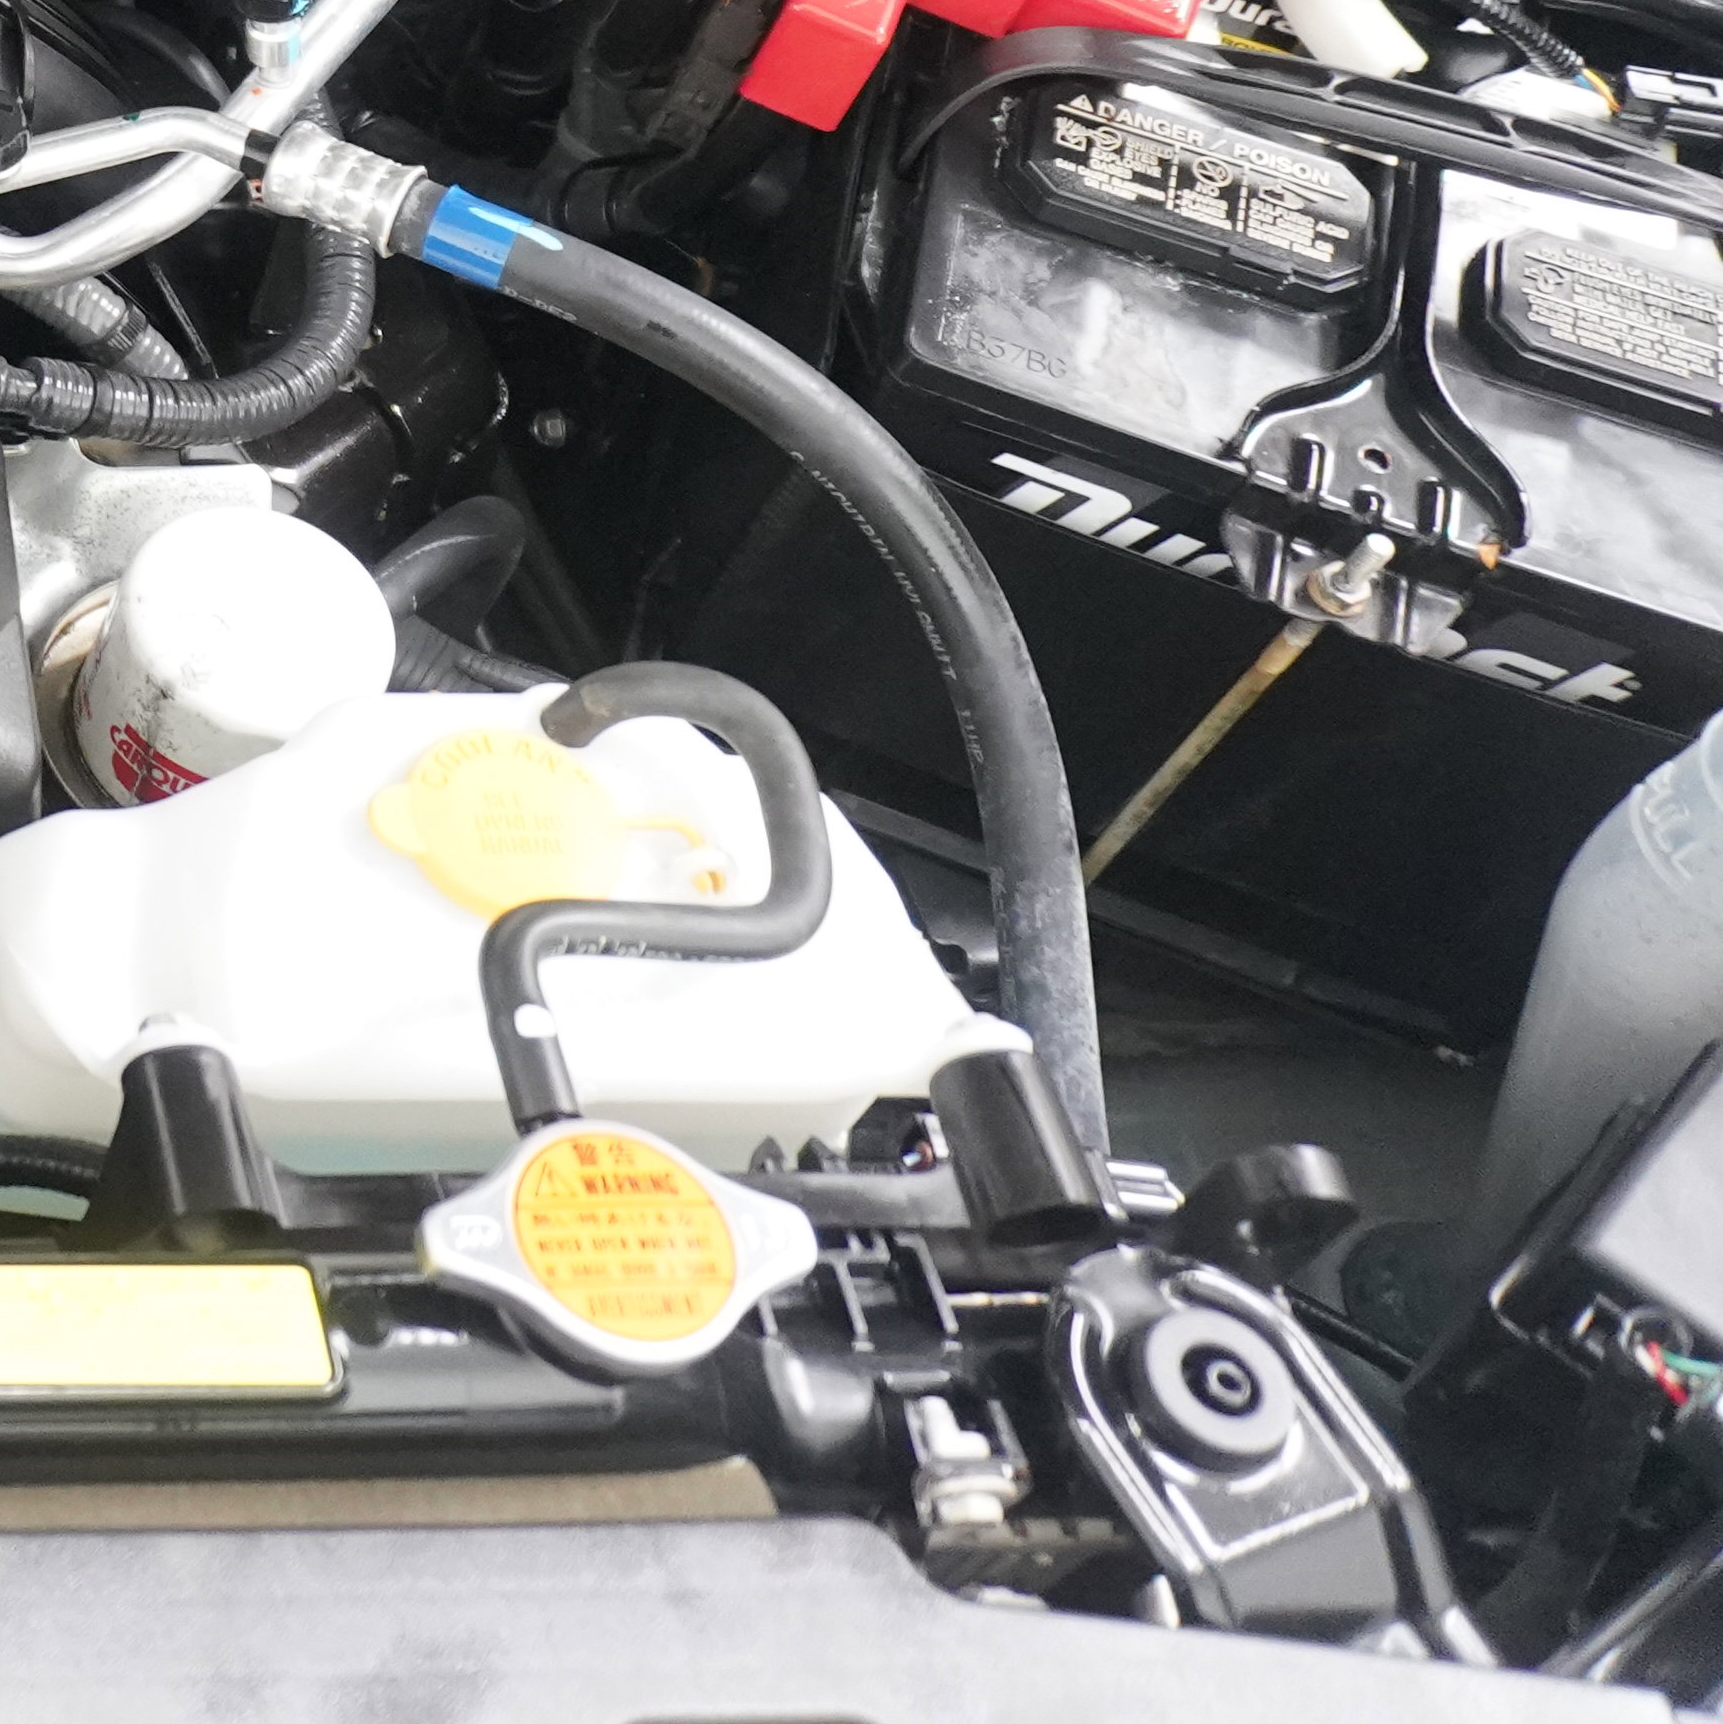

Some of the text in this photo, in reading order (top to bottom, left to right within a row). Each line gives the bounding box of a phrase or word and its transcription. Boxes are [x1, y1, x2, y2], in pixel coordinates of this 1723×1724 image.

[1096, 101, 1332, 186] DANGER / POISON
[580, 1170, 680, 1198] WARNING
